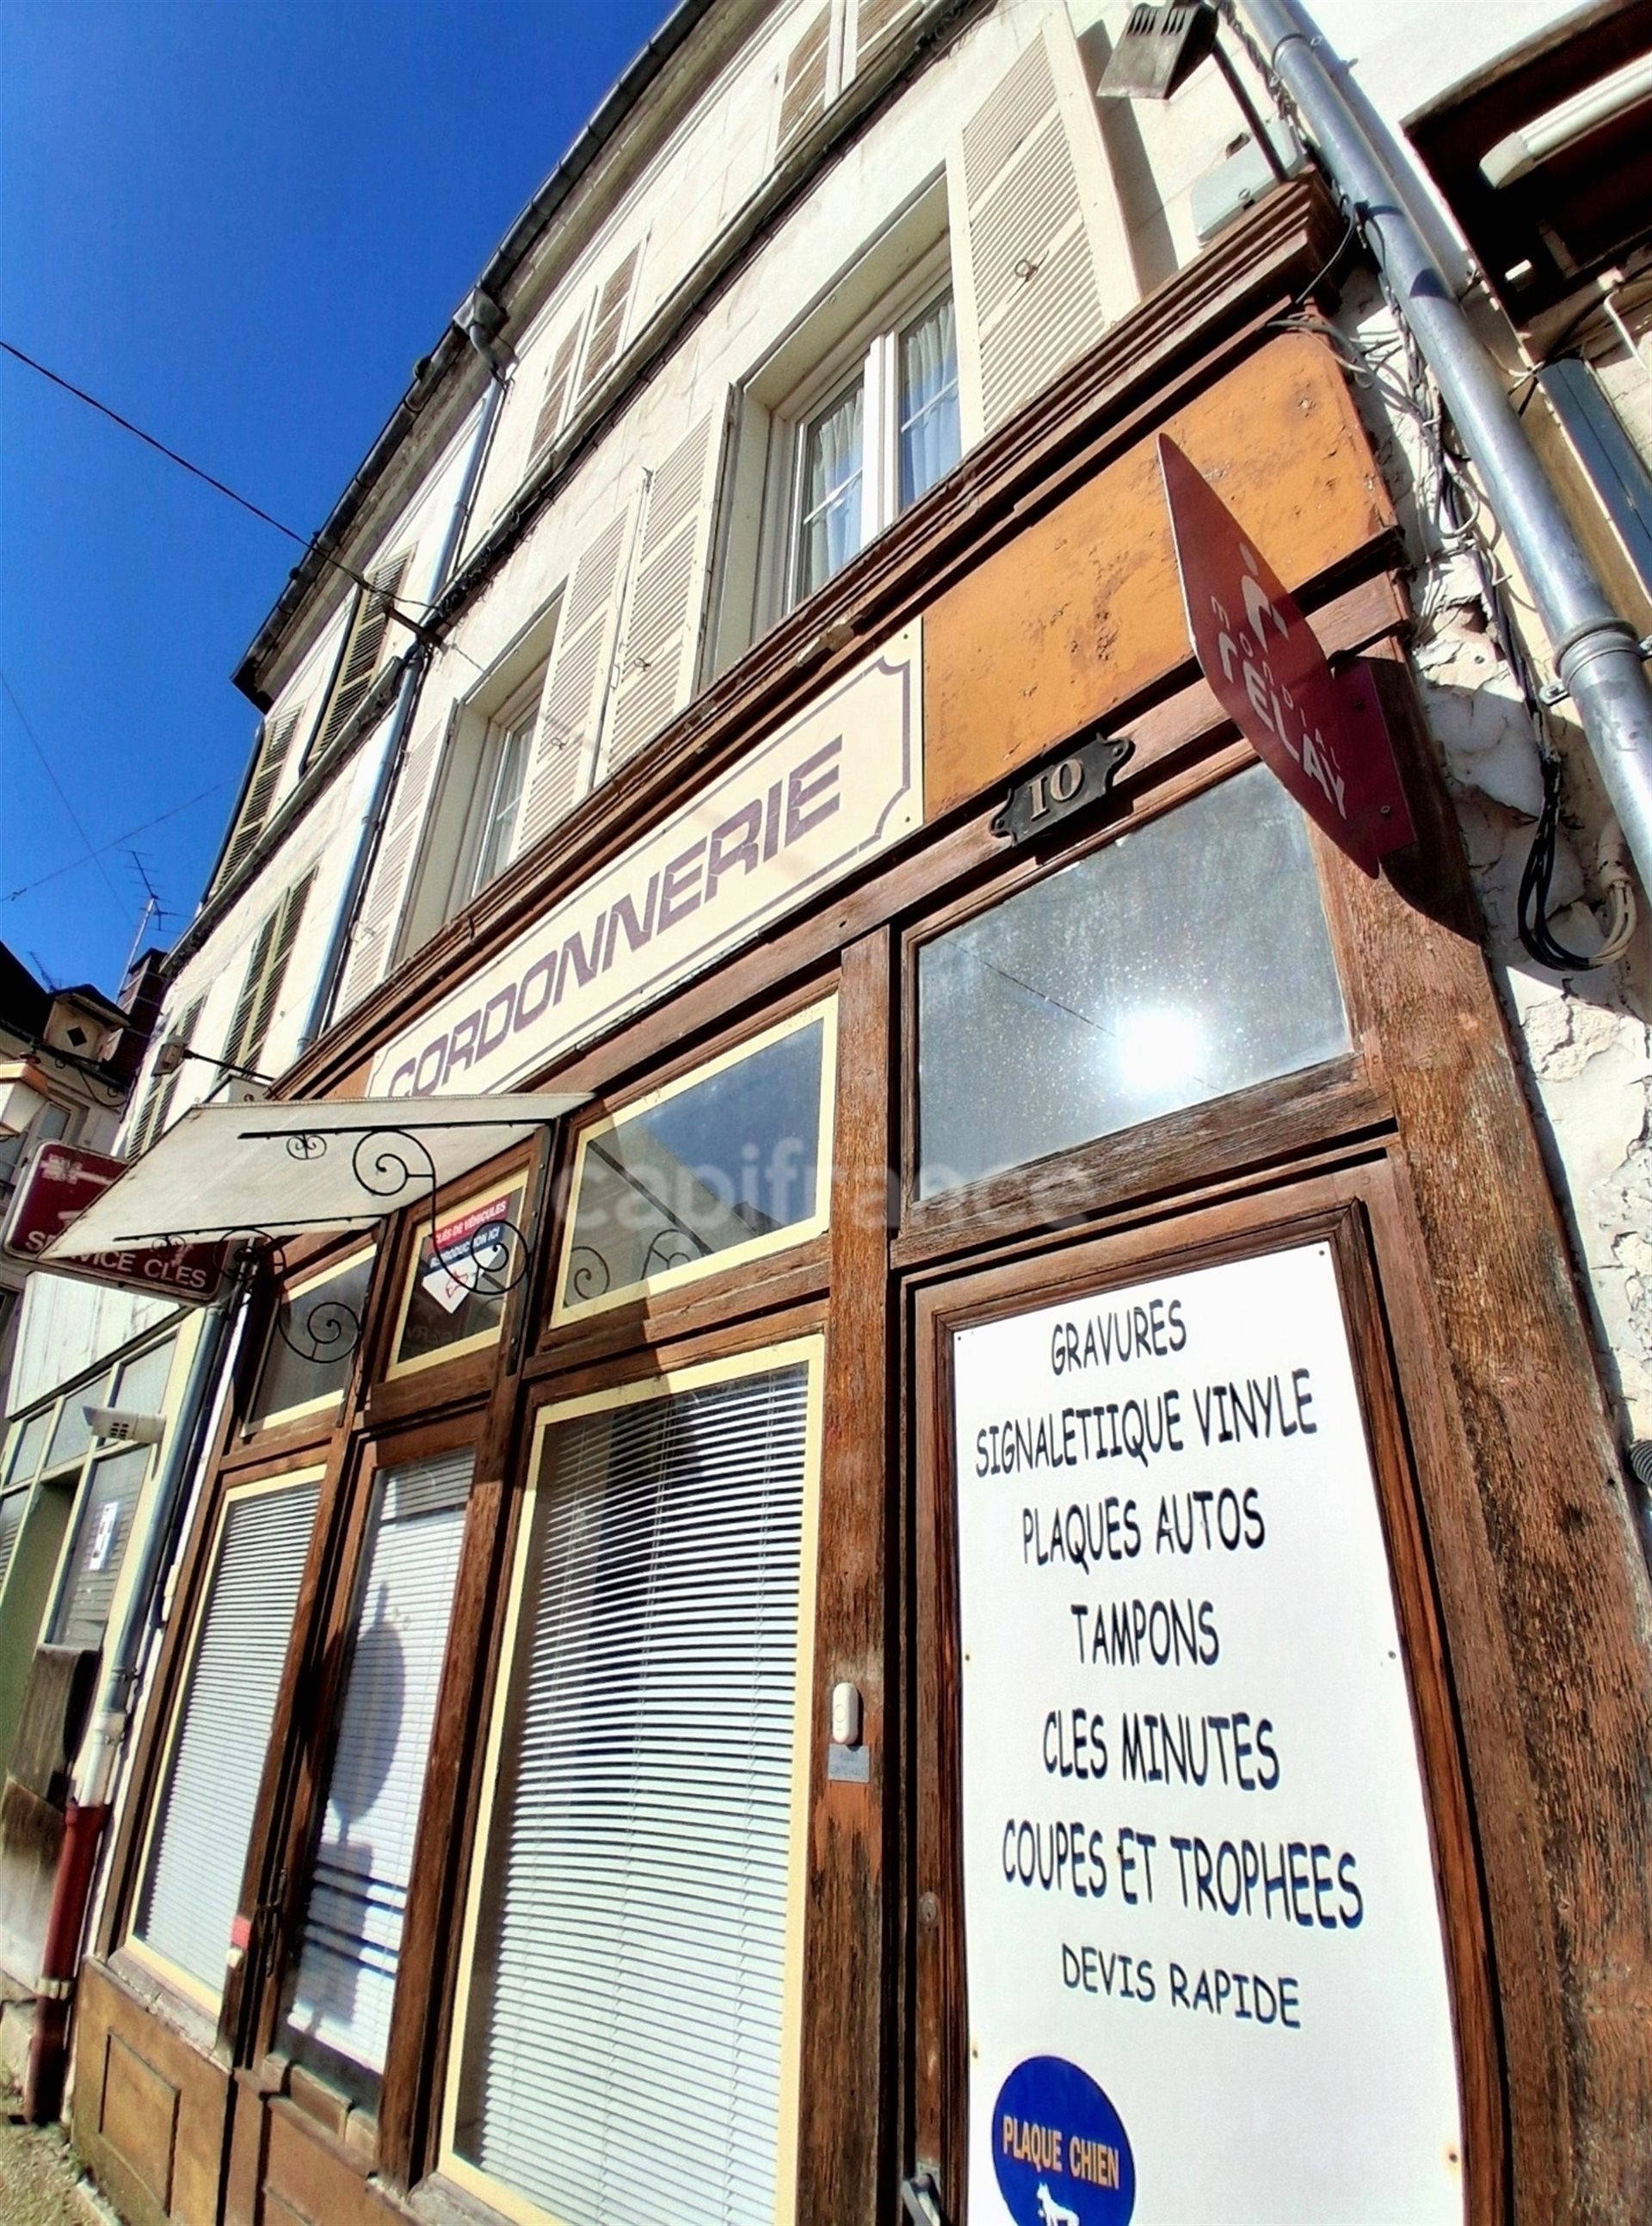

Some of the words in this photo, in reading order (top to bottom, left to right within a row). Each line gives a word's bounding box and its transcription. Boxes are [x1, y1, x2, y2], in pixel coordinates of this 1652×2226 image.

[1027, 759, 1082, 820] 10
[388, 734, 843, 1098] CORDONNERIE
[25, 1230, 136, 1273] SICE
[144, 1259, 206, 1289] CLES
[1051, 1298, 1187, 1376] GRAVURES
[976, 1389, 1184, 1477] SIGNALETIIQUE
[1193, 1368, 1317, 1446] VINYLE
[1022, 1496, 1142, 1575] PLAQUES
[1156, 1487, 1266, 1555] AUTOS
[1070, 1598, 1219, 1667] TAMPONS
[1043, 1708, 1108, 1780] CLES
[1122, 1712, 1280, 1791] MINUTES
[1002, 1819, 1107, 1898] COUPES
[1117, 1827, 1156, 1905] ET
[1169, 1835, 1364, 1929] TROPHEES
[1062, 1943, 1156, 2002] DEVIS
[1169, 1962, 1301, 2029] RAPIDE
[1003, 2114, 1063, 2174] PLAQUE
[1069, 2136, 1119, 2190] CHIEN
